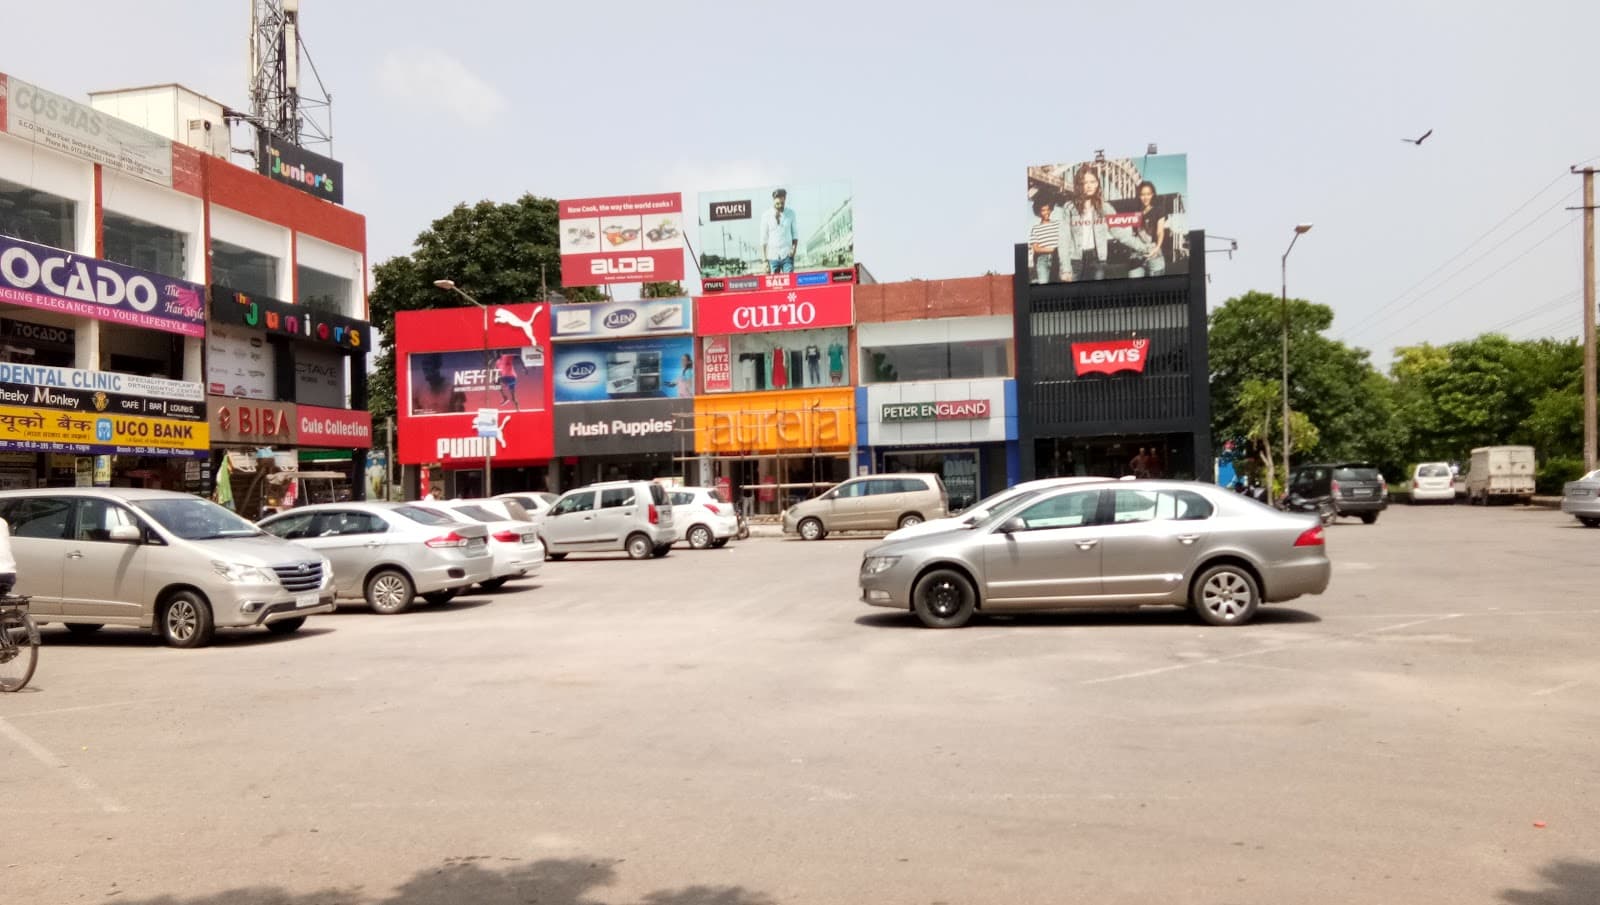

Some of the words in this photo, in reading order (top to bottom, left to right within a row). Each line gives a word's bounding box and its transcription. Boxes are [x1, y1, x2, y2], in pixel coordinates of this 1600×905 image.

[272, 157, 334, 193] Junior's
[567, 206, 581, 214] Now
[599, 203, 610, 211] the
[610, 204, 622, 212] way
[623, 202, 633, 210] the
[634, 200, 652, 209] world
[715, 203, 746, 214] mufti
[164, 283, 181, 299] The
[765, 278, 790, 287] SALE
[36, 296, 94, 315] ELEGANCE
[97, 306, 110, 318] TO
[112, 309, 138, 322] YOUR
[164, 301, 183, 317] Hair
[184, 306, 205, 322] Style
[733, 292, 816, 329] curio
[15, 323, 67, 343] TOCADO
[246, 303, 361, 346] Junior's
[1, 364, 66, 387] DENTAL
[72, 372, 122, 391] CLINIC
[34, 386, 80, 409] Monkey
[149, 402, 162, 411] BAR
[239, 406, 290, 436] BIBA
[883, 405, 919, 418] PETER
[921, 403, 986, 417] ENGLAND
[0, 412, 46, 433] यूको
[56, 414, 92, 431] बैंक
[116, 420, 148, 437] UCO
[153, 423, 193, 440] BANK
[302, 416, 323, 435] Cute
[325, 419, 369, 437] Collection
[569, 420, 609, 437] Hush
[612, 418, 673, 437] Puppies
[712, 399, 841, 445] aurelia
